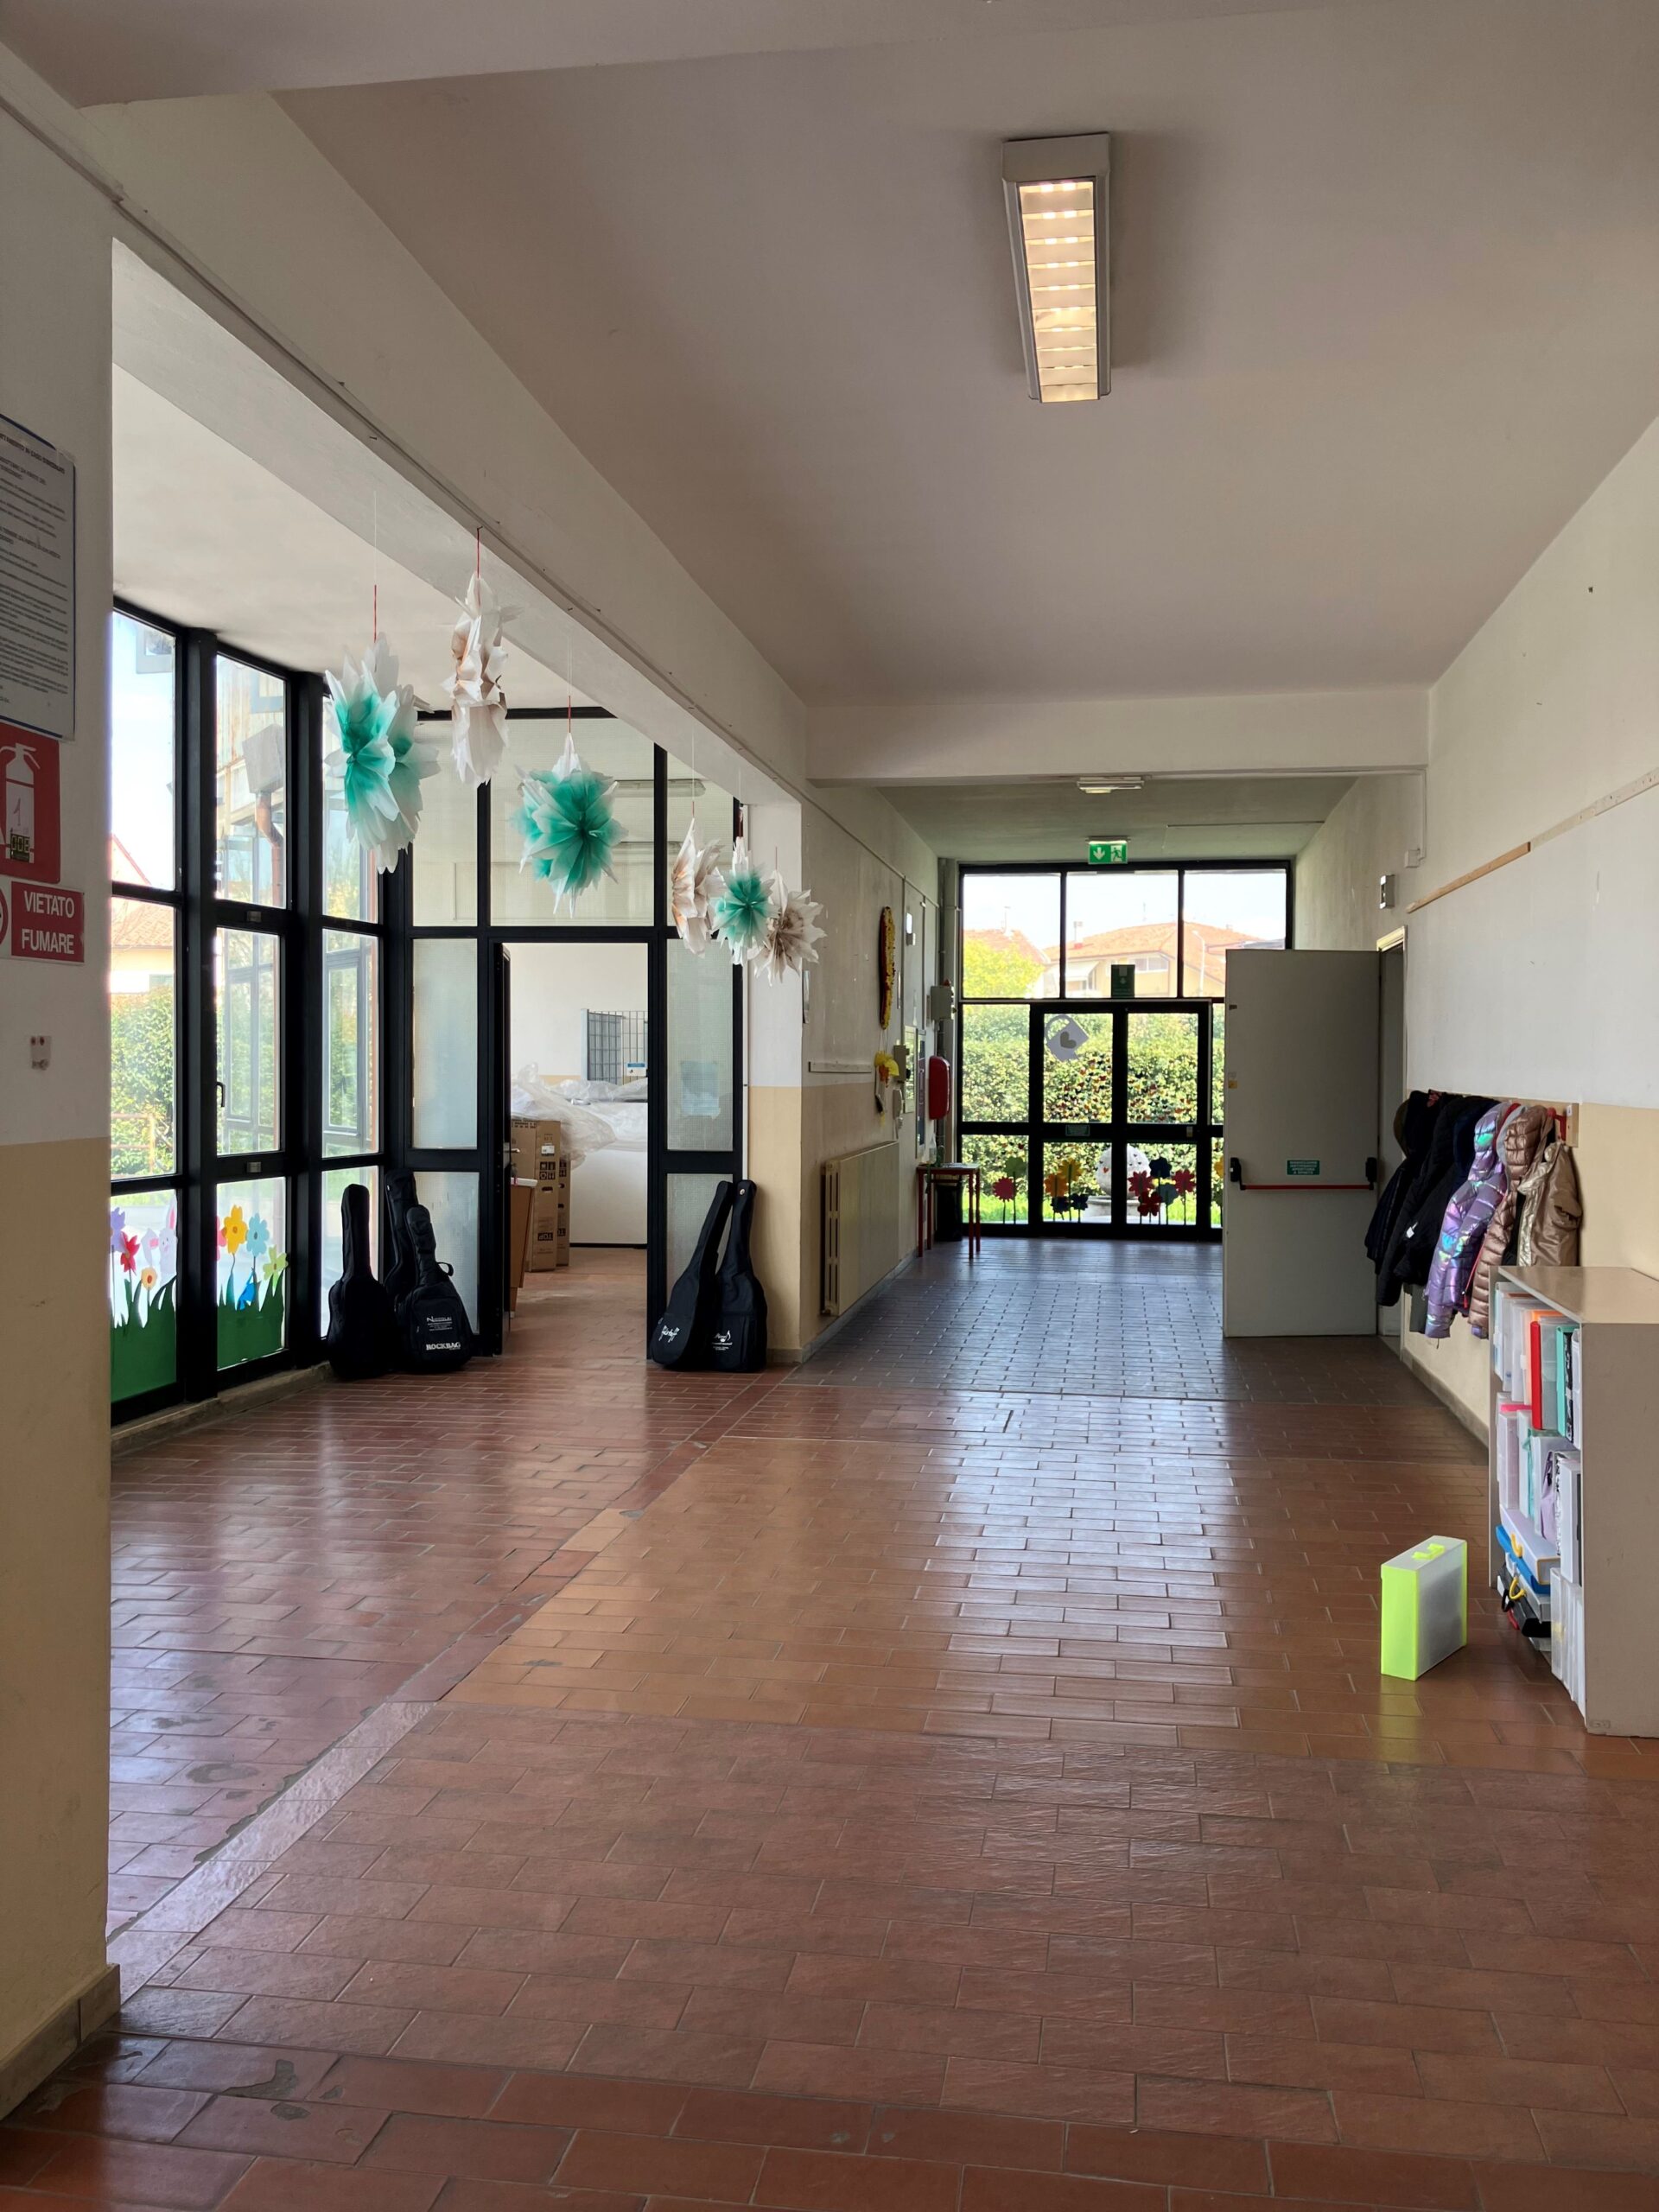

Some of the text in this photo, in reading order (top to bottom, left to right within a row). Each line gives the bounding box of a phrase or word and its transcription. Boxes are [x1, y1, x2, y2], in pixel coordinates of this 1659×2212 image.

[23, 890, 75, 918] VIETATO
[22, 928, 75, 955] FUMARE
[425, 1341, 461, 1351] ROCKBAG
